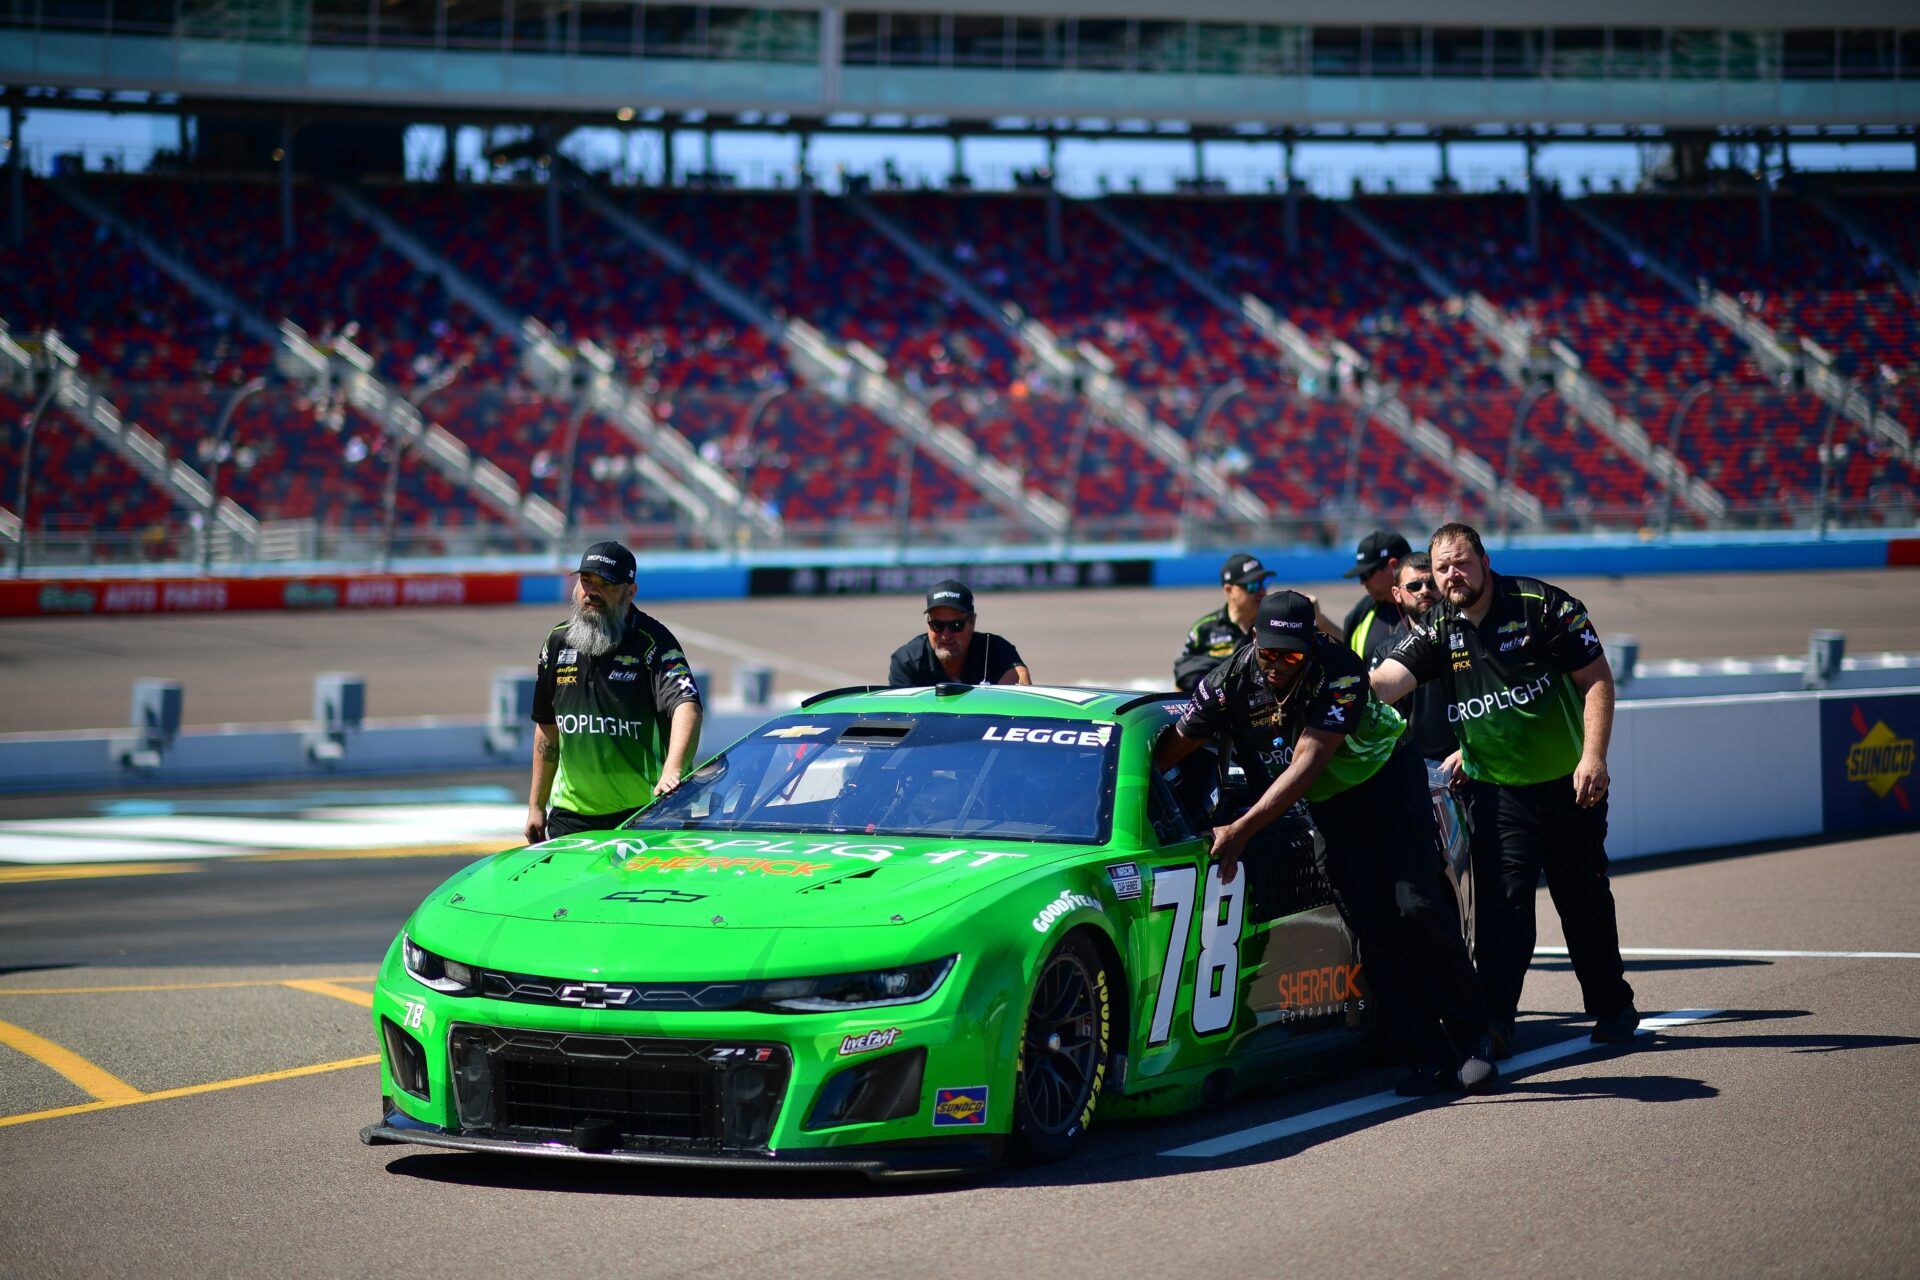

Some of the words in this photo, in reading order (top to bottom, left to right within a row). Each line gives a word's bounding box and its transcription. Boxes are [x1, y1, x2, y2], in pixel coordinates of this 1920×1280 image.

[1270, 619, 1304, 629] DROPLIGHT
[1447, 672, 1551, 723] DROPLIGHT
[554, 714, 642, 740] ROPLIGHT
[1850, 742, 1912, 777] SUNOCO
[624, 855, 833, 877] SHERFICK
[1032, 889, 1104, 933] GOODYEAR
[1147, 861, 1245, 1045] 78
[1279, 963, 1363, 1009] SHERFICK
[403, 1000, 425, 1029] 78
[1281, 999, 1365, 1024] COMPANIES
[939, 1101, 984, 1113] SUNOCO
